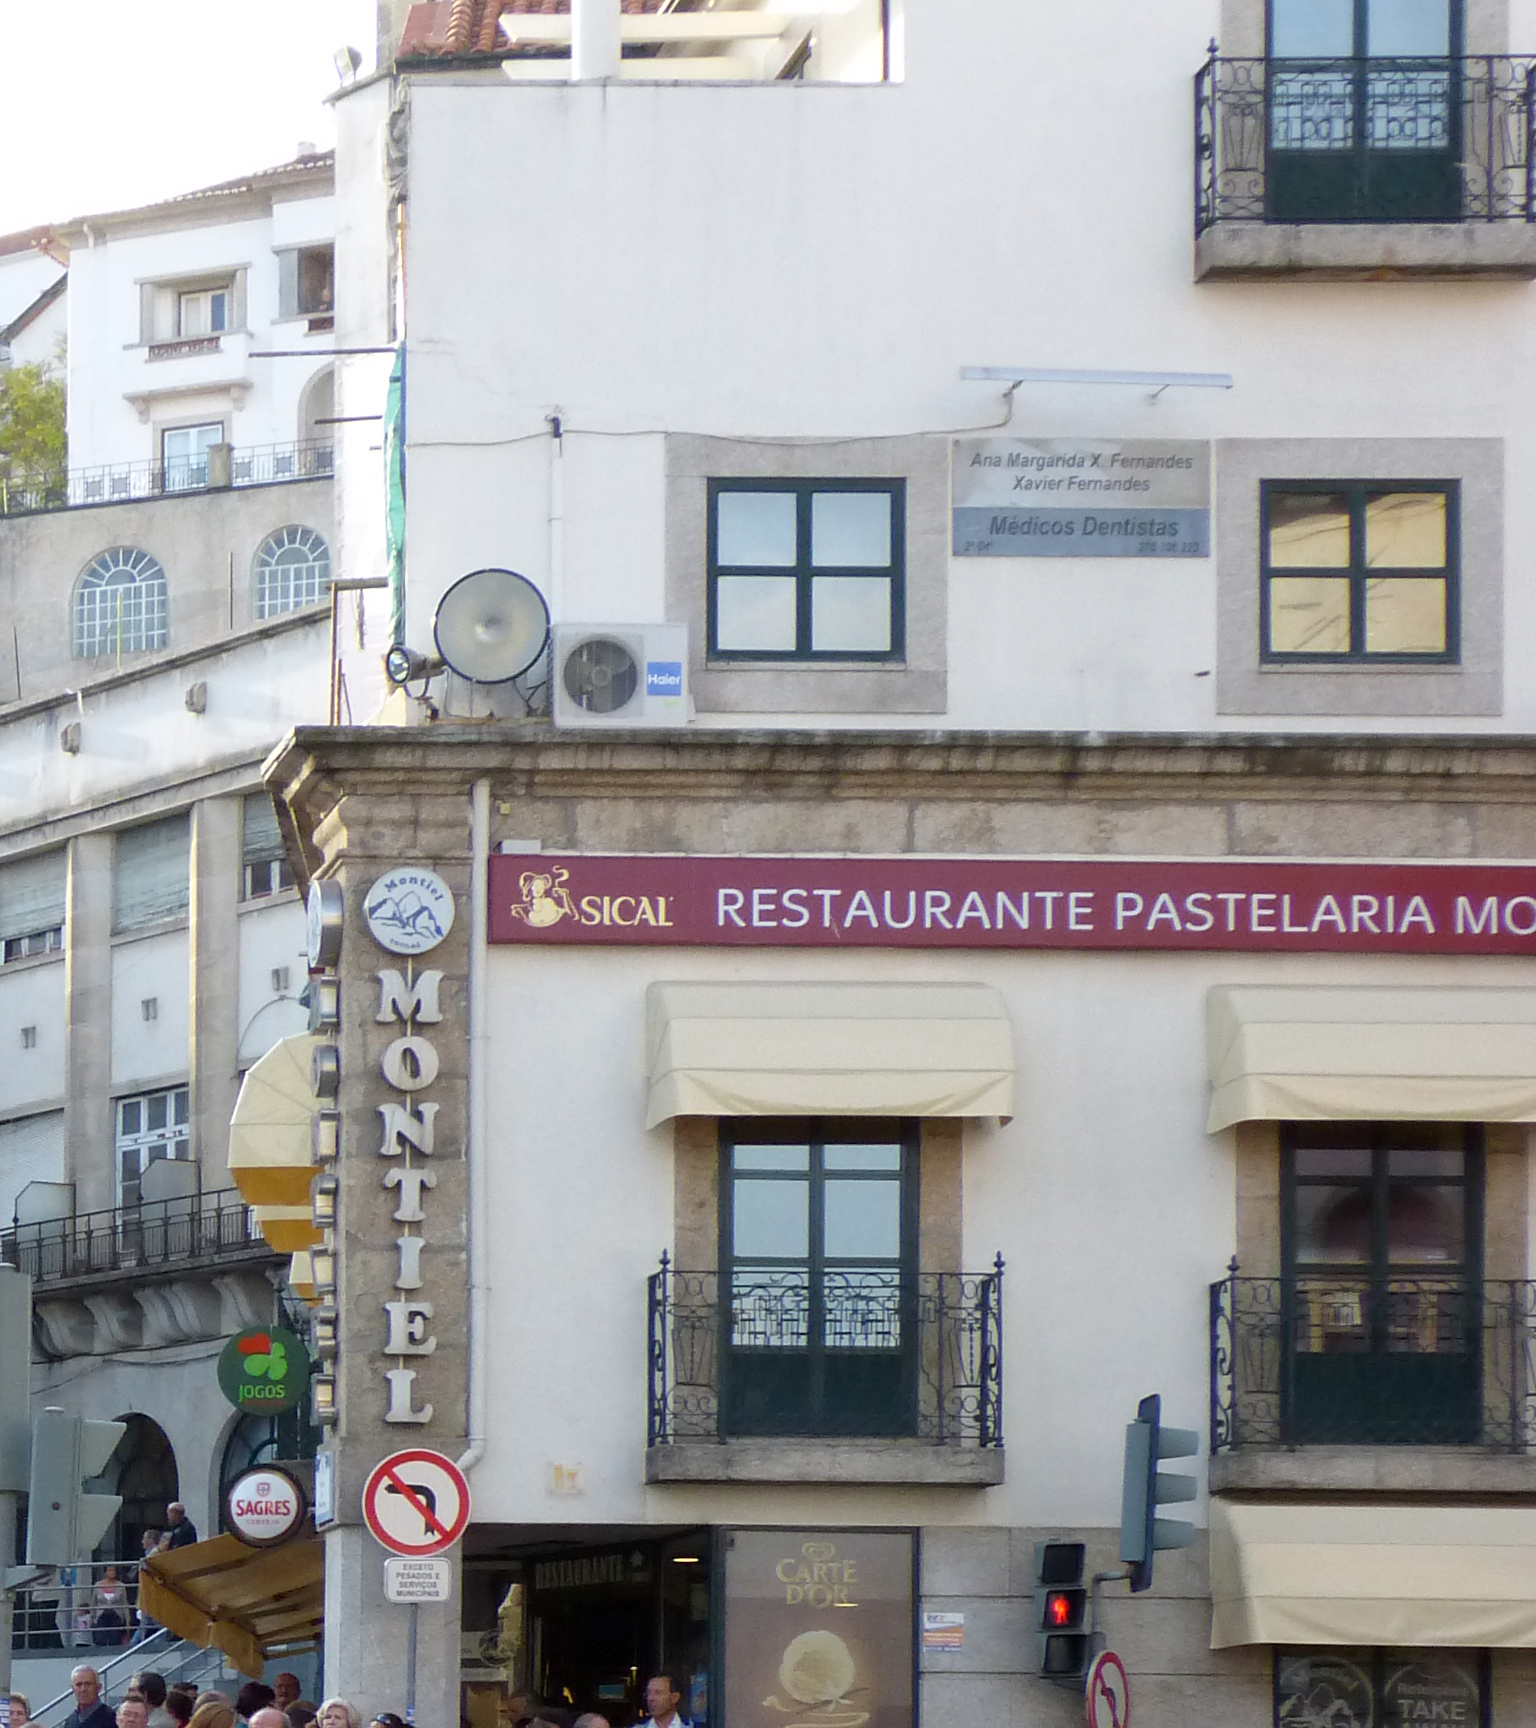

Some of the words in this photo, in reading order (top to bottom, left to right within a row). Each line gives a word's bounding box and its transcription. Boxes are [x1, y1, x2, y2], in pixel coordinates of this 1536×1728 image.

[970, 452, 1002, 468] Ana
[1007, 452, 1085, 471] Margarida
[1110, 453, 1193, 470] Fernandes
[1013, 475, 1064, 491] Xavier
[1068, 475, 1151, 492] Fernandes
[989, 515, 1075, 537] Médicos
[1081, 515, 1179, 538] Dentistas
[647, 672, 681, 686] Haier
[384, 875, 444, 902] Montiel
[581, 895, 673, 927] SICAL
[717, 887, 1094, 931] RESTAURANTE
[1115, 891, 1435, 934] PASTELARIA
[375, 968, 444, 1423] MONTIEL
[239, 1384, 286, 1402] JOGOS
[236, 1499, 291, 1517] SAGRES
[396, 1572, 433, 1580] PESADOS
[776, 1558, 859, 1584] CARTE
[399, 1581, 437, 1589] SERVIÇOS
[786, 1584, 850, 1609] D'OR
[1397, 1699, 1466, 1720] TAKE
